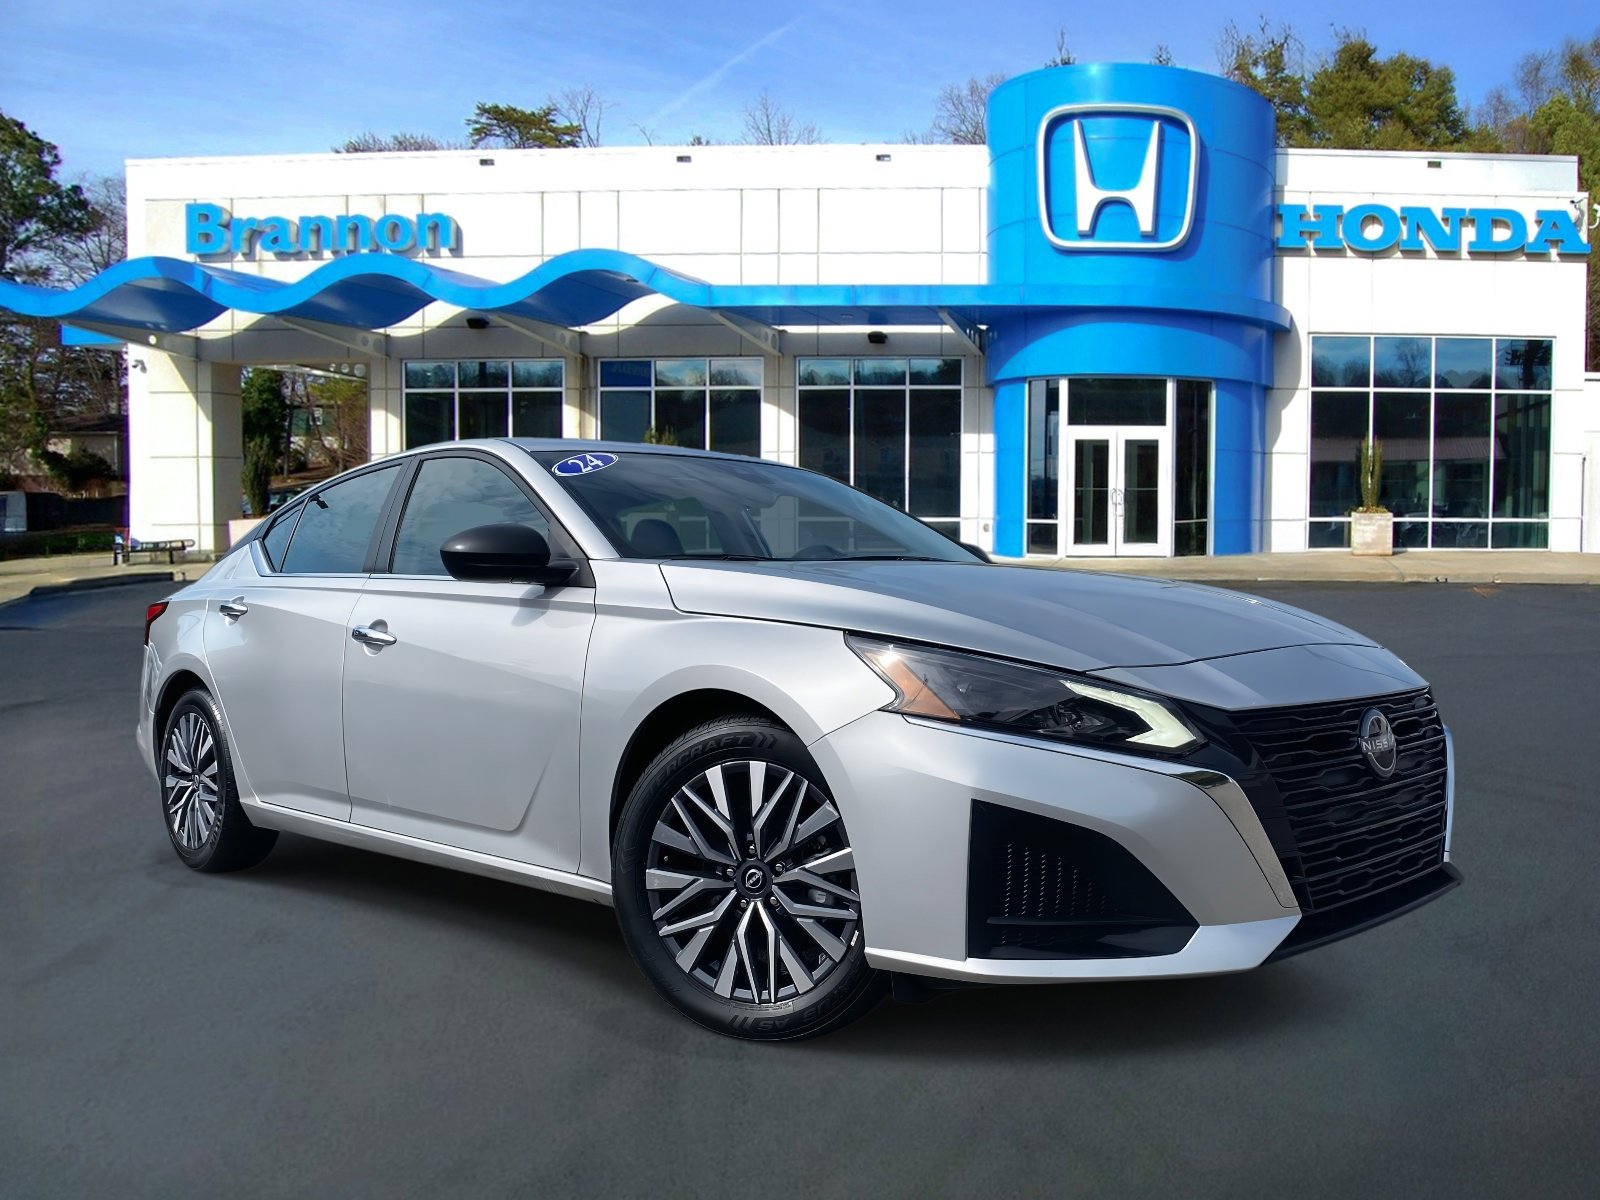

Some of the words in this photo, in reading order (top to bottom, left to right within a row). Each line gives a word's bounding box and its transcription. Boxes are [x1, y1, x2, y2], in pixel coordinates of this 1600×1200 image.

[185, 203, 458, 257] Brannon
[1277, 203, 1591, 255] HONDA
[567, 454, 605, 473] 24
[1361, 738, 1393, 751] NISS
